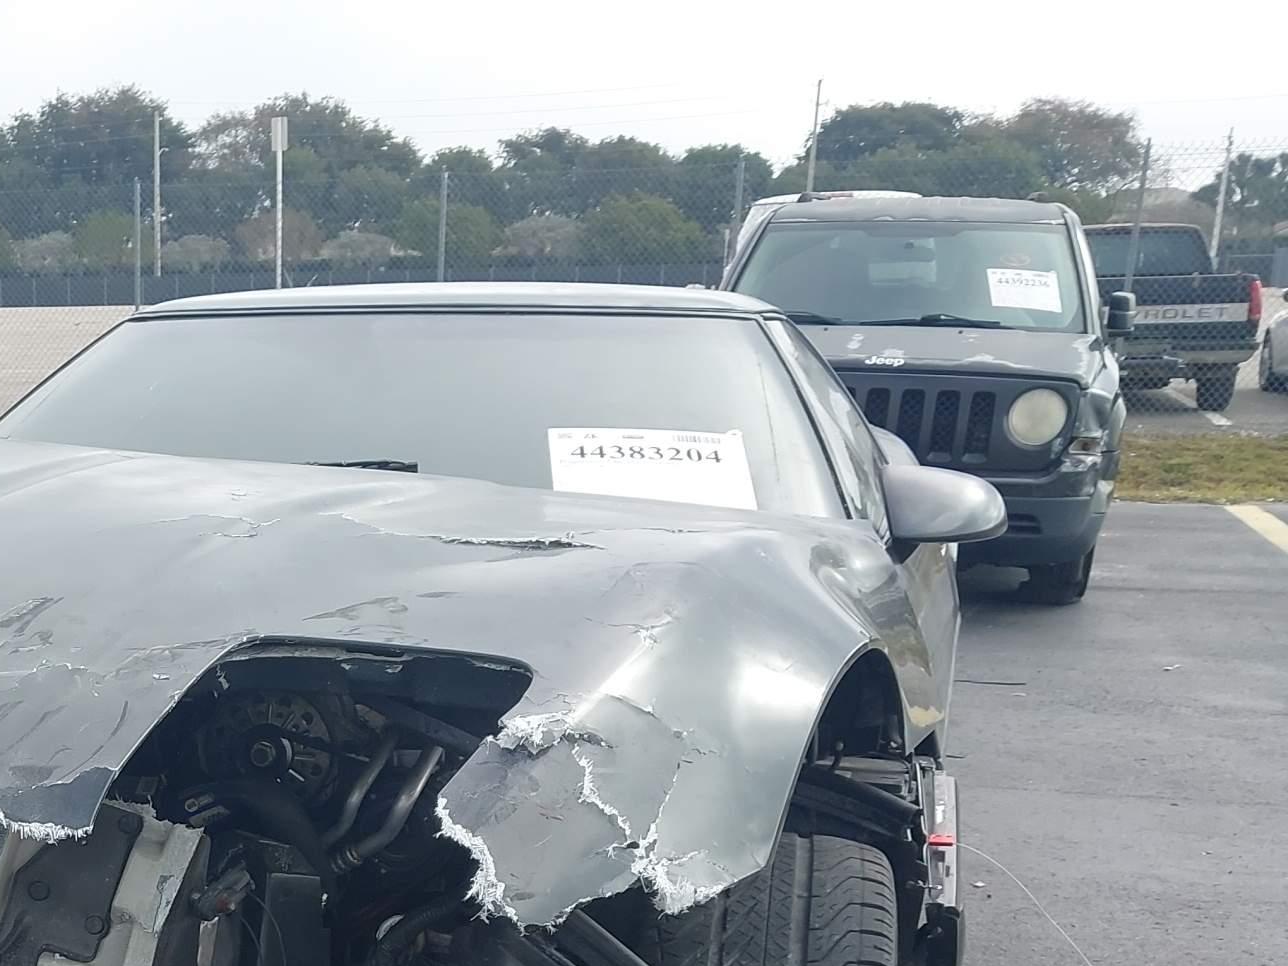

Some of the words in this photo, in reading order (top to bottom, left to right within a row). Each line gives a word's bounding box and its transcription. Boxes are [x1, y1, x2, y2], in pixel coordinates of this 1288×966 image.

[1132, 306, 1230, 320] ROLET
[865, 355, 905, 367] Jeep
[570, 444, 723, 463] 44383204
